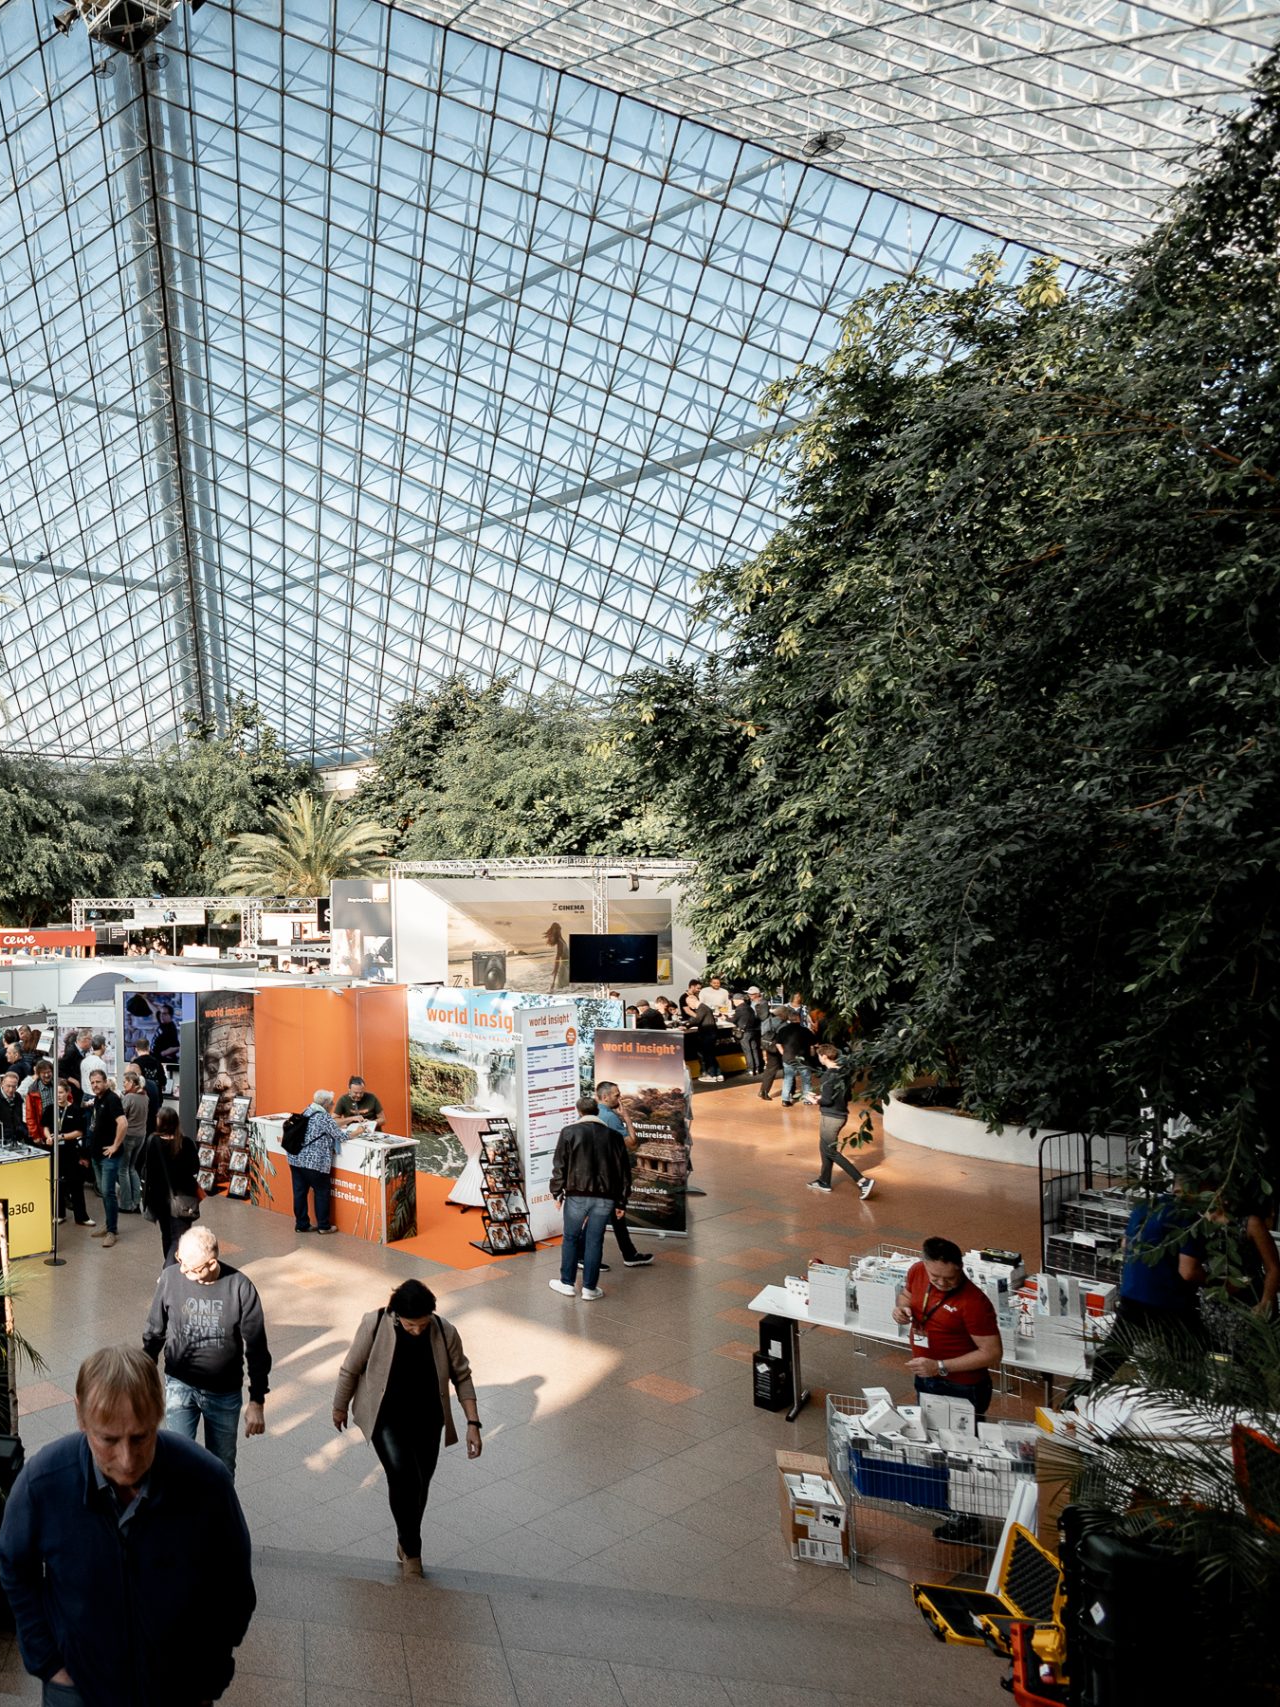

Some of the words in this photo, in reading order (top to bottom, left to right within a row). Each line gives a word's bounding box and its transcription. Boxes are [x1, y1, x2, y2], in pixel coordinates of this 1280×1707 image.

[3, 934, 35, 945] cewe
[427, 1007, 468, 1025] world
[474, 1009, 513, 1033] insig
[528, 1015, 547, 1027] world
[548, 1013, 570, 1026] insight
[602, 1042, 633, 1053] world
[636, 1043, 675, 1056] insight
[635, 1131, 675, 1141] nisreisen.
[330, 1177, 357, 1191] ummer
[330, 1188, 367, 1206] nisreisen.
[8, 1202, 35, 1217] a360
[185, 1297, 223, 1315] ONE
